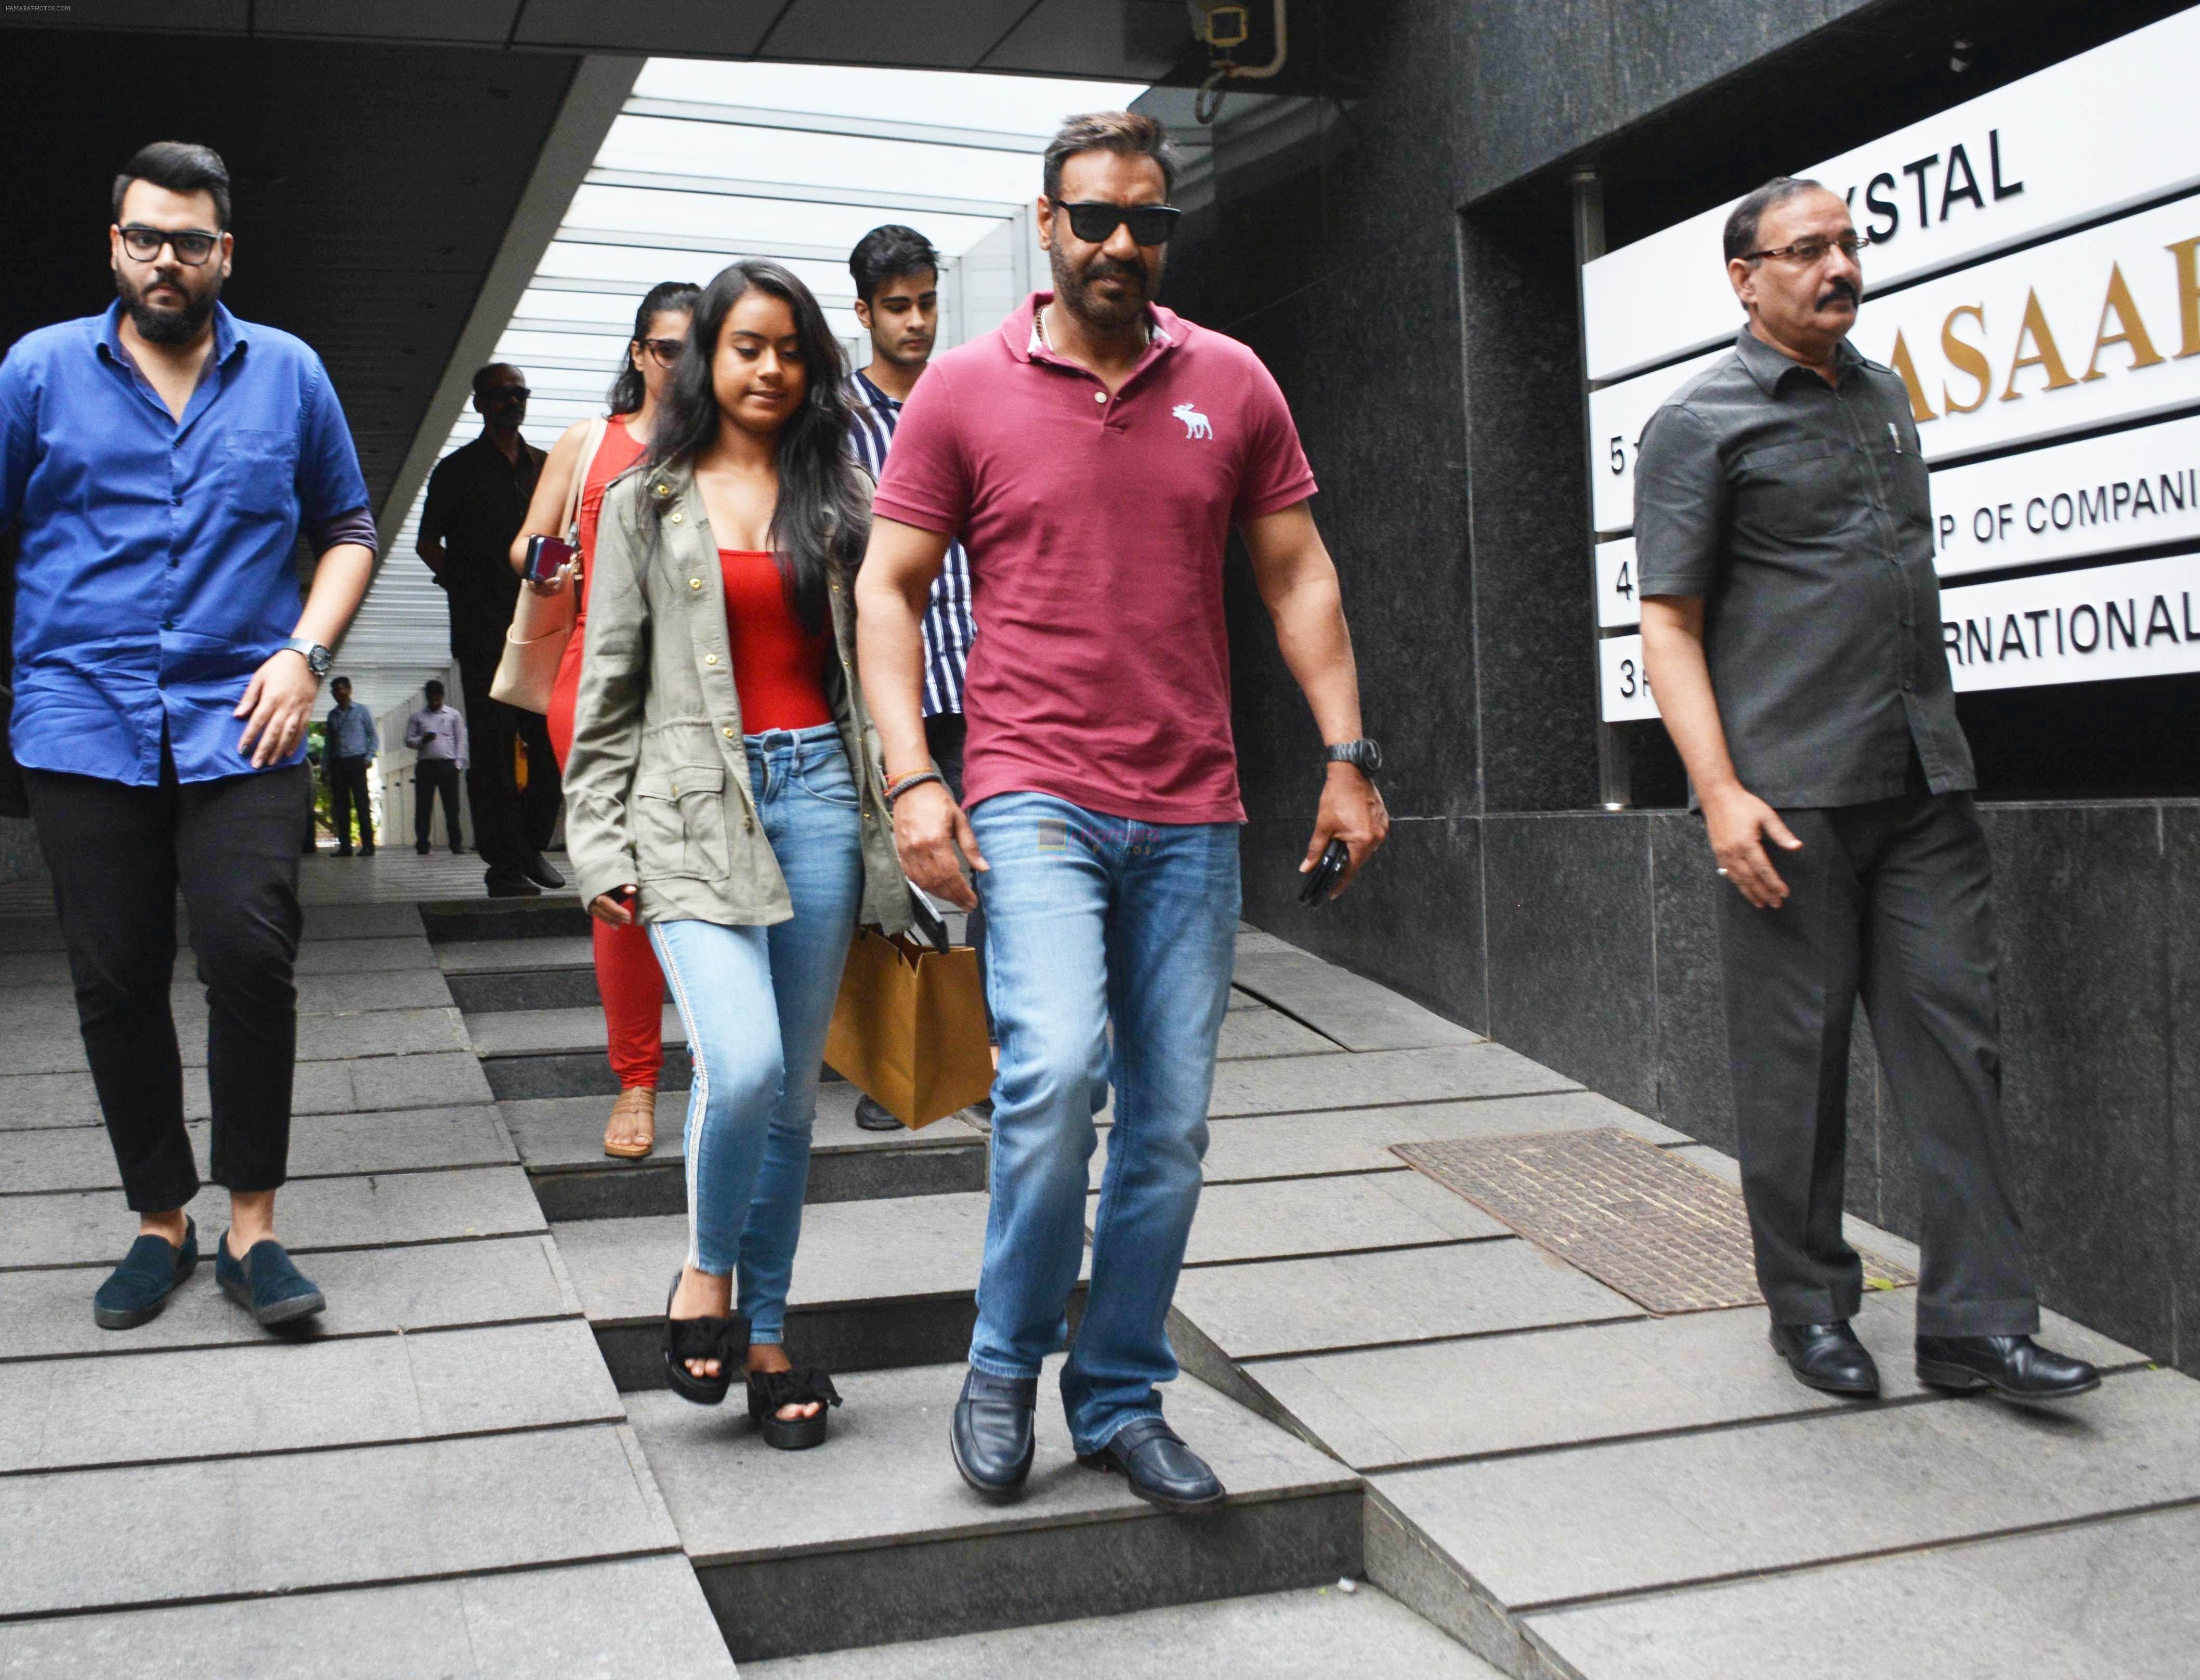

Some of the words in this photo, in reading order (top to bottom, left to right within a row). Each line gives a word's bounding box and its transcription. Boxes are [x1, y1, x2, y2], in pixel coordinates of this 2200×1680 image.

[1845, 129, 2023, 244] STAL
[1973, 503, 2013, 543] OF
[2026, 469, 2198, 534] COMPANI
